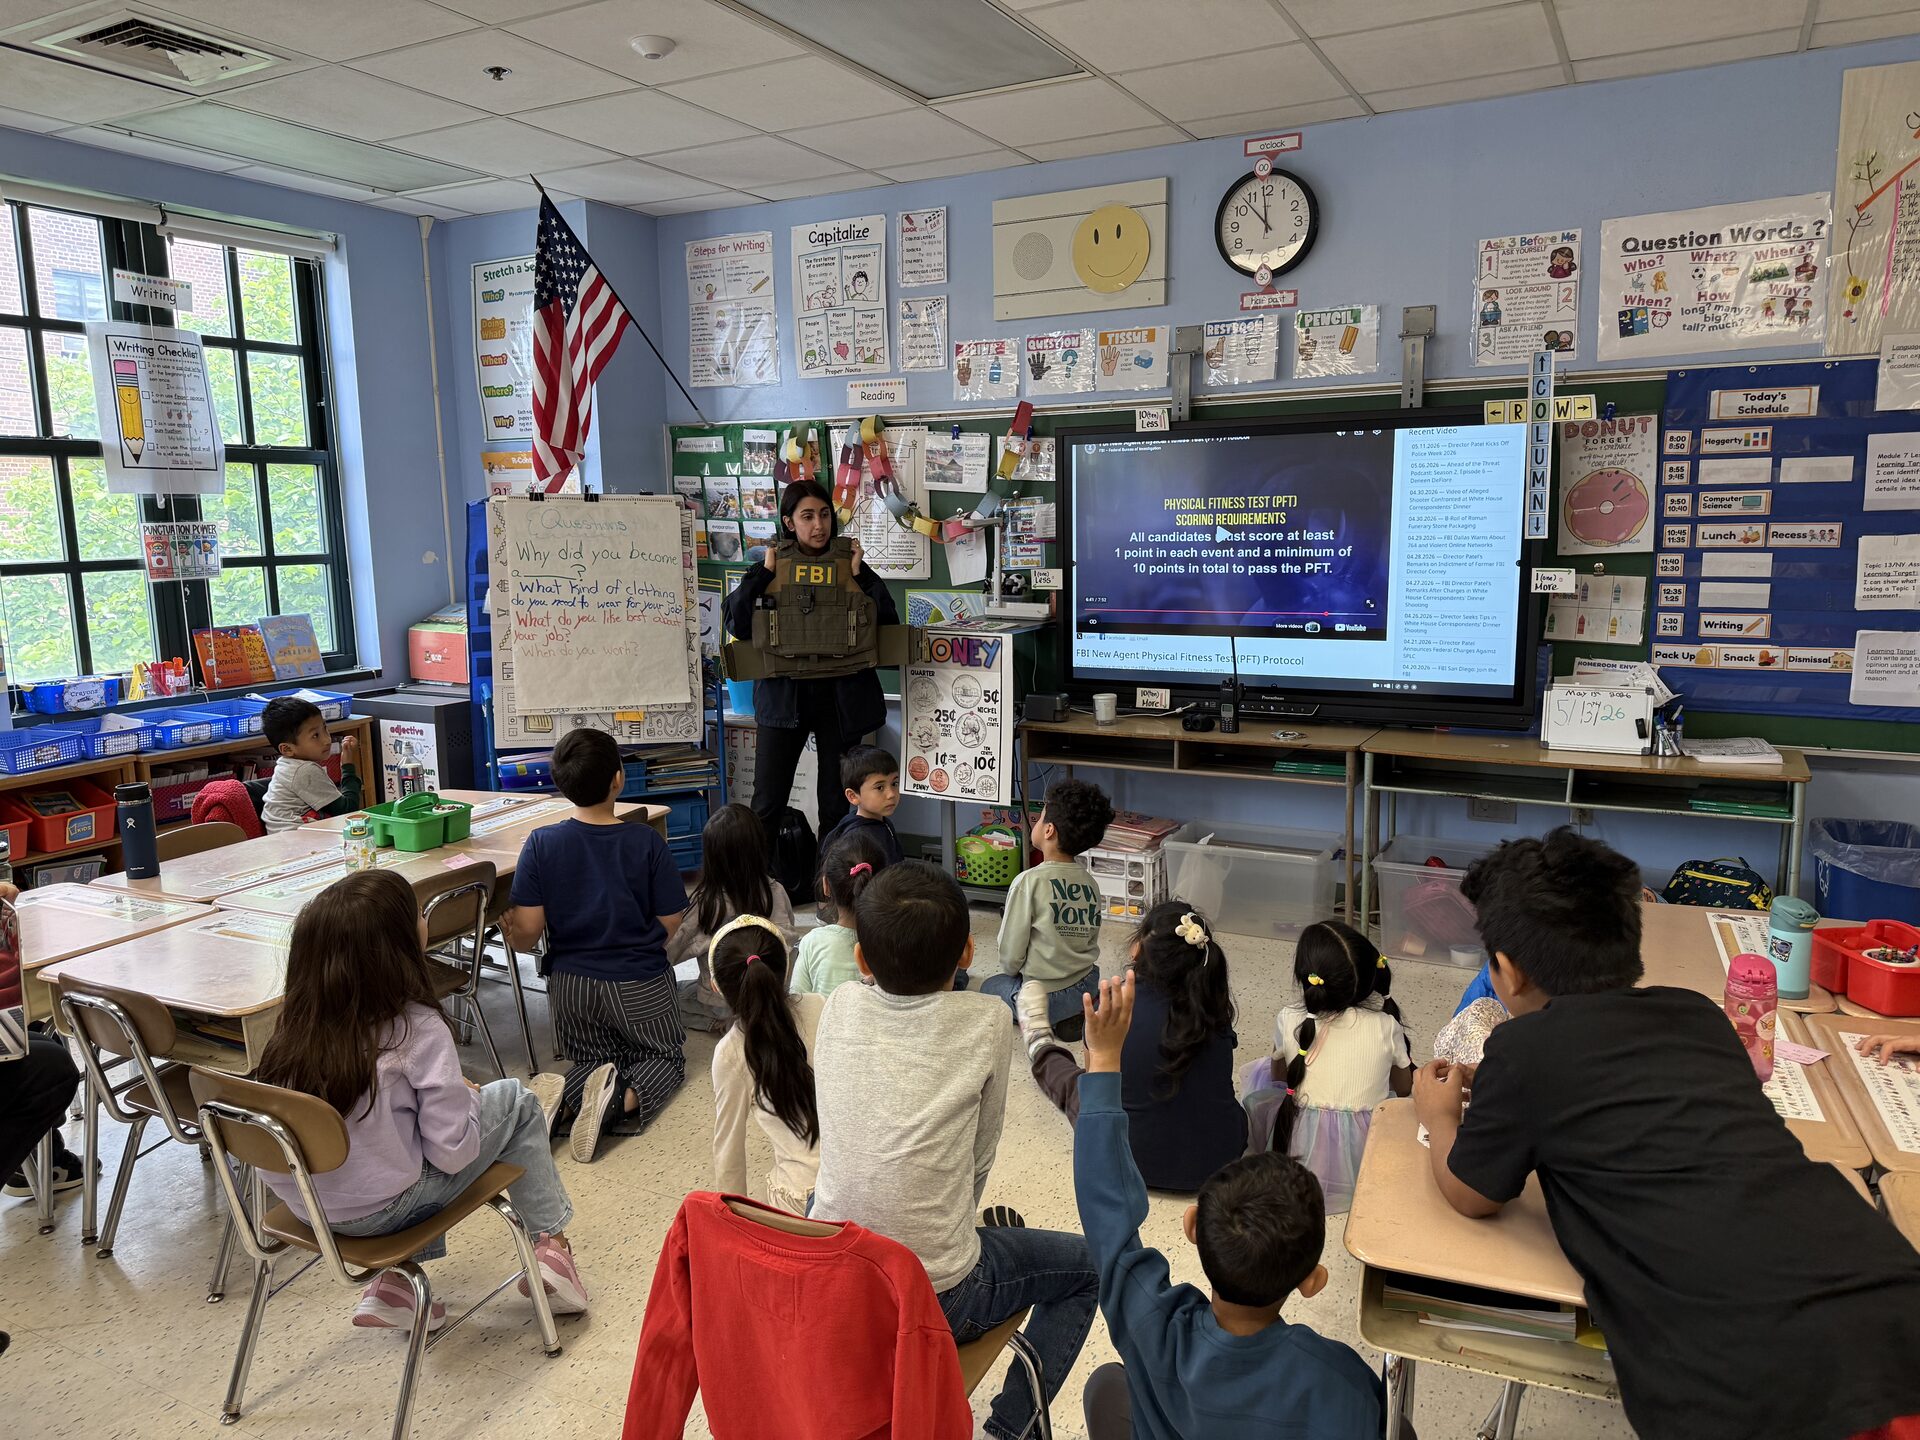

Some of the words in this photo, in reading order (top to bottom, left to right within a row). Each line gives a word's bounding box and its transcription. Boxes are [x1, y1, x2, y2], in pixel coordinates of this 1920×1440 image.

[1260, 139, 1285, 150] o'clock
[1261, 184, 1274, 196] 12
[1234, 205, 1248, 217] 10
[1291, 200, 1299, 211] 2
[1231, 222, 1240, 233] 9
[809, 224, 869, 246] Capitalize
[1485, 240, 1504, 250] Ask
[1509, 238, 1516, 248] 3
[1520, 236, 1557, 246] Before
[1561, 232, 1576, 242] Me
[1622, 231, 1722, 253] Question
[1730, 222, 1803, 243] Words
[694, 247, 715, 257] Steps
[719, 245, 729, 253] for
[733, 240, 764, 251] Writing
[1516, 246, 1547, 254] YOURSELF
[1624, 255, 1664, 273] Who?
[1691, 251, 1737, 264] What?
[1755, 241, 1814, 261] Where?
[484, 265, 515, 281] Stretch
[131, 285, 176, 305] Writing
[482, 290, 504, 303] Who?
[1624, 295, 1671, 310] When?
[1698, 291, 1730, 302] How
[1769, 284, 1811, 298] Why?
[1681, 304, 1711, 316] long?
[1714, 304, 1751, 315] many?
[1304, 310, 1354, 327] PENCIL
[1704, 313, 1728, 324] big?
[1682, 323, 1706, 332] tall?
[1708, 319, 1744, 332] much?
[1028, 336, 1081, 350] QUESTION
[1107, 330, 1149, 344] TISSUE
[114, 340, 154, 356] Writing
[158, 345, 198, 359] Checklist
[481, 354, 507, 366] When?
[484, 385, 513, 398] Where?
[860, 390, 895, 403] Reading
[1743, 392, 1786, 402] Today's
[1738, 404, 1790, 414] Schedule
[494, 416, 514, 428] Why?
[1142, 420, 1158, 428] Less
[1564, 417, 1652, 438] DONUT
[1532, 379, 1547, 511] COLUMN
[1586, 437, 1629, 445] FORGET
[1705, 437, 1743, 446] Heggerty
[1164, 498, 1206, 510] PHYSICAL
[1208, 497, 1245, 509] FITNESS
[1248, 496, 1270, 508] TEST
[1272, 495, 1297, 508] (PFT)
[1703, 495, 1742, 504] Computer
[1176, 514, 1213, 526] SCORING
[1216, 512, 1286, 526] REQUIREMENTS
[1130, 532, 1144, 542] All
[1148, 532, 1211, 542] candidates
[1248, 532, 1284, 541] score
[1287, 531, 1299, 541] at
[1303, 530, 1334, 540] least
[1702, 531, 1736, 540] Lunch
[1772, 531, 1807, 539] Recess
[516, 541, 549, 568] Why
[558, 540, 583, 559] did
[592, 551, 620, 565] you
[630, 541, 678, 565] become
[1114, 548, 1120, 558] 1
[1125, 547, 1153, 559] point
[1156, 547, 1167, 557] in
[1170, 547, 1197, 557] each
[1201, 548, 1234, 557] event
[1237, 547, 1260, 557] and
[1263, 549, 1271, 557] a
[1275, 546, 1334, 557] minimum
[1338, 545, 1352, 557] of
[796, 565, 832, 584] FBI
[1133, 563, 1146, 573] 10
[1150, 563, 1185, 575] points
[1188, 563, 1199, 573] in
[1203, 563, 1229, 573] total
[1232, 564, 1244, 573] to
[1248, 565, 1277, 575] pass
[1281, 563, 1301, 573] the
[1305, 563, 1333, 573] PFT.
[520, 579, 562, 594] What
[606, 579, 622, 595] of
[626, 581, 675, 604] clothing
[1535, 582, 1559, 591] More
[516, 611, 551, 627] What
[558, 609, 571, 625] do
[574, 614, 596, 629] you
[604, 612, 621, 624] like
[627, 610, 646, 623] best
[1346, 624, 1366, 632] YouTube
[1704, 620, 1743, 632] Writing
[1076, 649, 1089, 658] FBI
[1093, 650, 1111, 658] New
[1113, 651, 1139, 661] Agent
[1142, 651, 1178, 662] Physical
[1181, 653, 1212, 662] Fitness
[1237, 655, 1260, 665] (PFT)
[1263, 656, 1304, 665] Protocol
[1656, 651, 1679, 659] Pack
[1682, 652, 1695, 662] Up
[1724, 654, 1755, 662] Snack
[1788, 656, 1831, 664] Dismissal
[70, 690, 98, 698] Crayons
[983, 689, 999, 704] 5¢
[934, 709, 956, 722] 25¢
[390, 725, 424, 736] adjective
[974, 757, 996, 771] 10¢
[961, 787, 976, 795] DIME
[1050, 879, 1097, 902] New
[1049, 903, 1101, 926] York
